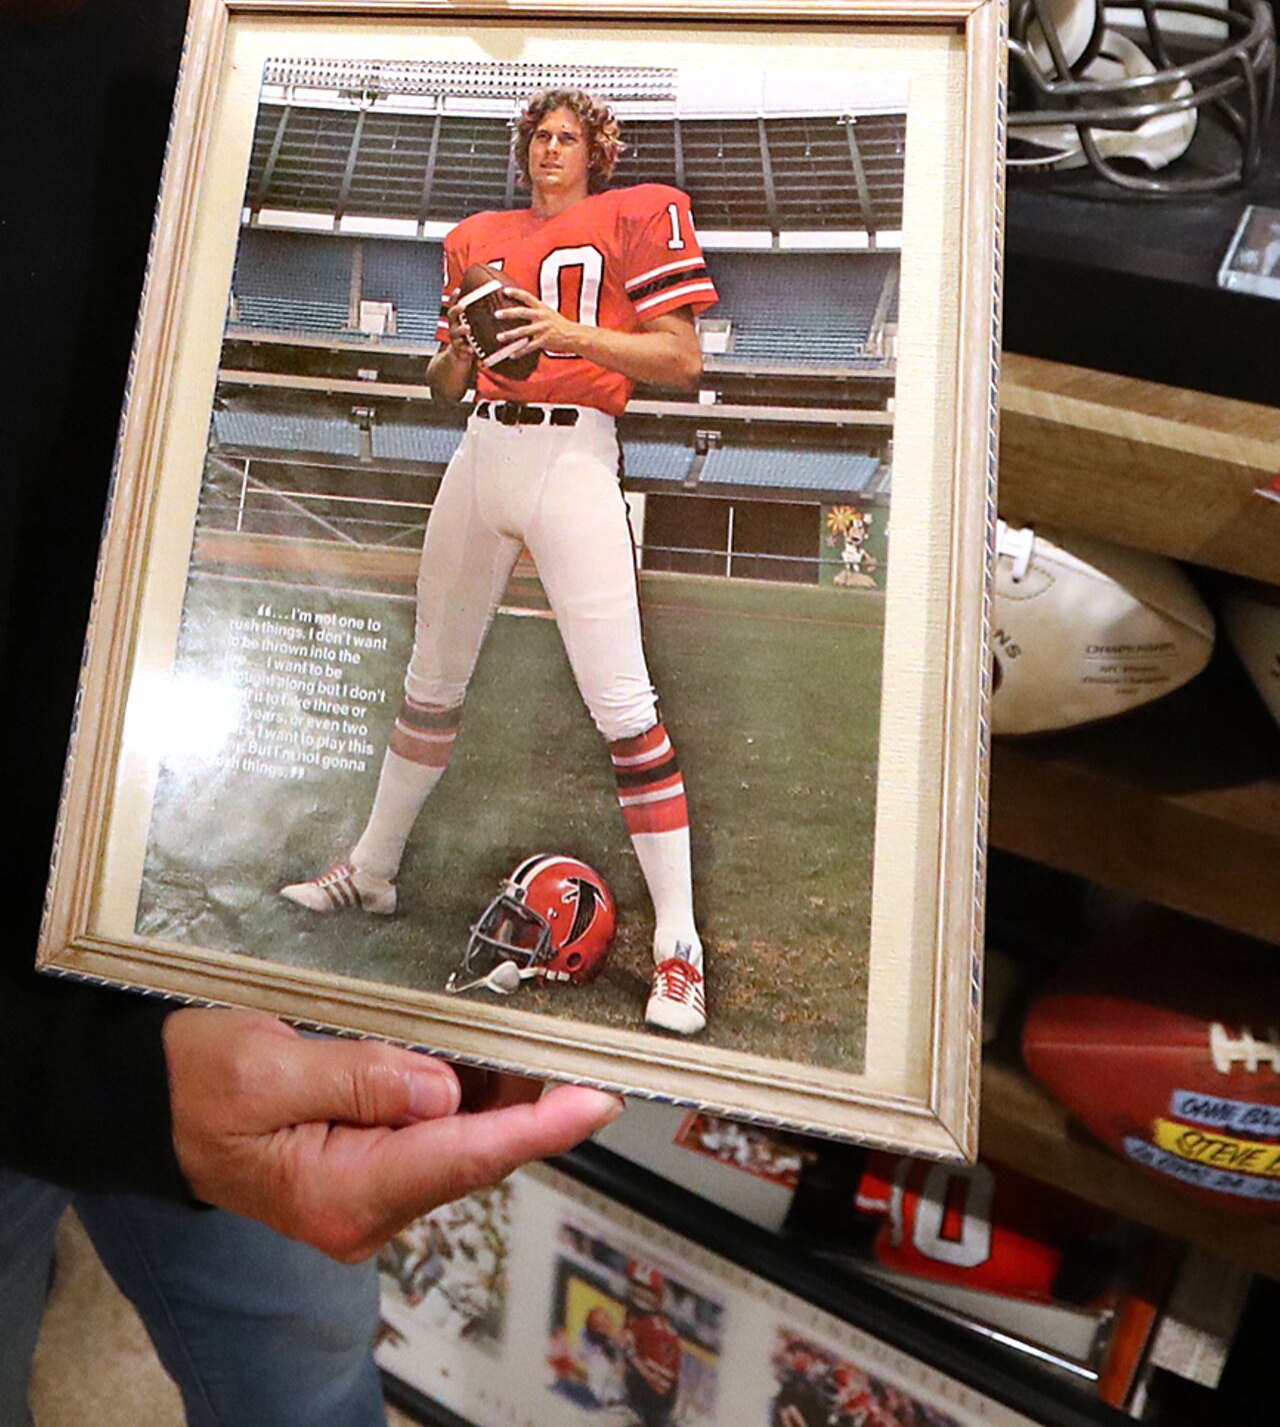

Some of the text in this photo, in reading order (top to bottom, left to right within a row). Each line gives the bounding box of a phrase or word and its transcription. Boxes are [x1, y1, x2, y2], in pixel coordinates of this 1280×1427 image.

[229, 619, 259, 632] rush
[315, 629, 351, 647] don't
[353, 634, 388, 651] want
[315, 613, 337, 627] not
[338, 617, 365, 631] one
[368, 618, 382, 632] to
[227, 634, 240, 647] to
[261, 638, 308, 658] thrown
[310, 645, 336, 662] into
[338, 649, 361, 665] the
[272, 659, 308, 675] want
[309, 662, 323, 676] to
[325, 664, 343, 680] be
[276, 678, 315, 695] along
[317, 682, 340, 698] but
[349, 686, 386, 704] don't
[313, 698, 350, 717] three
[351, 704, 368, 719] or
[308, 717, 340, 734] even
[342, 721, 370, 737] two
[264, 728, 299, 745] want
[301, 732, 315, 747] to
[317, 735, 347, 758] play
[347, 739, 375, 756] this
[297, 748, 320, 765] not
[322, 754, 367, 772] gonna
[1177, 1130, 1268, 1167] STEVE
